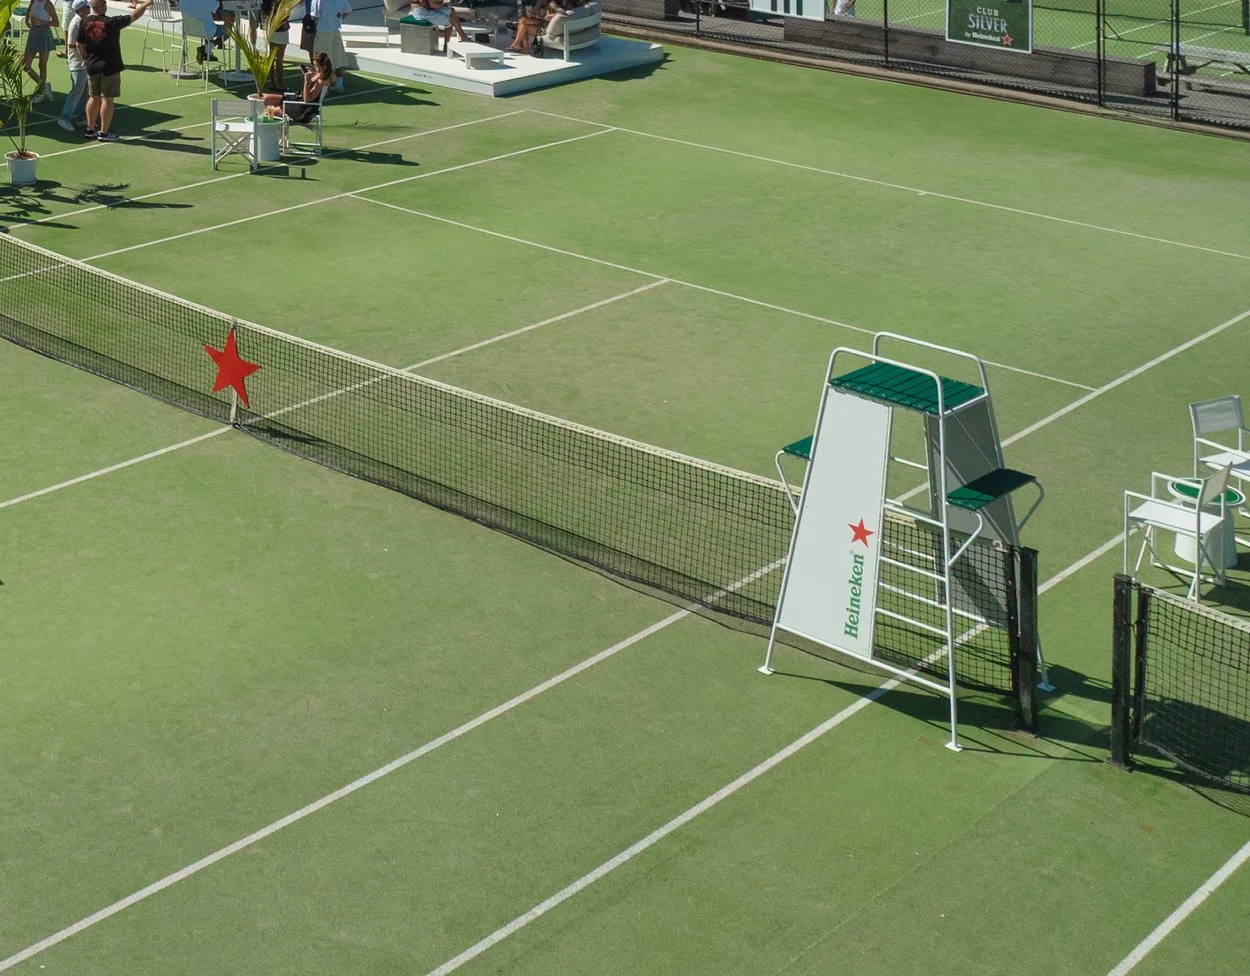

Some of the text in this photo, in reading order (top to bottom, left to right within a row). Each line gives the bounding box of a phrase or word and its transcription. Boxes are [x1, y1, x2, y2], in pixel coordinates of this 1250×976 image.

[976, 6, 999, 16] CLUB
[967, 13, 1008, 34] SILVER
[972, 31, 1001, 42] Heineken
[844, 553, 864, 640] Heineken
